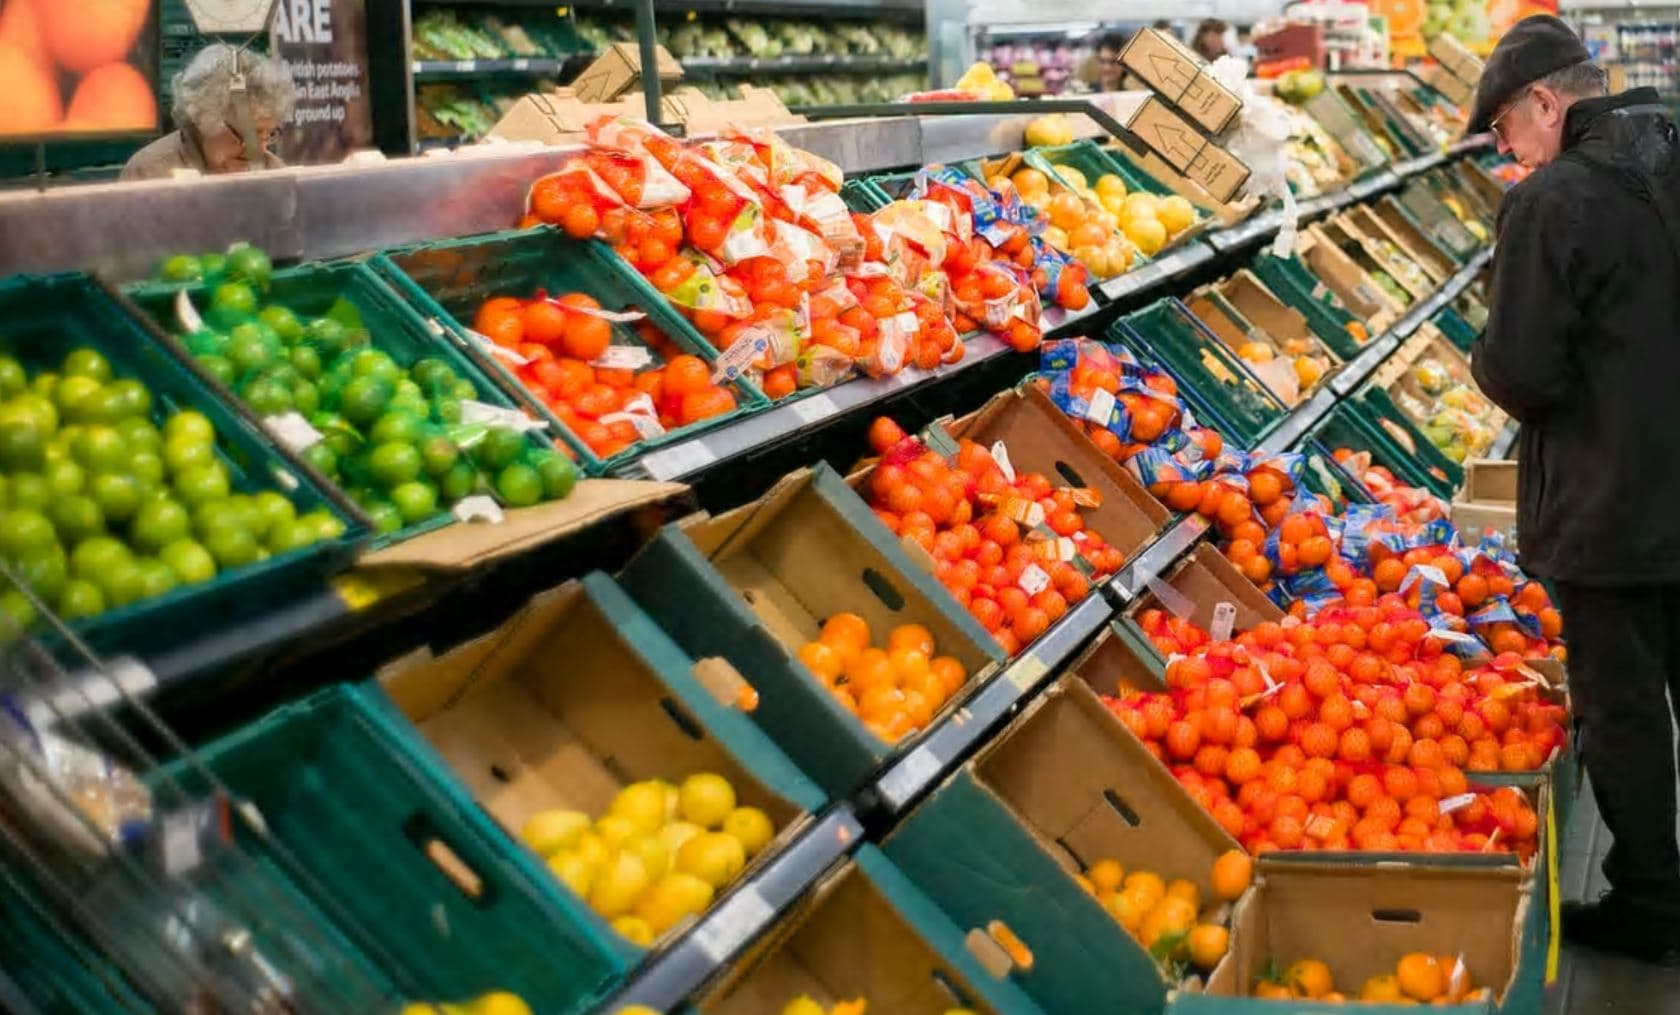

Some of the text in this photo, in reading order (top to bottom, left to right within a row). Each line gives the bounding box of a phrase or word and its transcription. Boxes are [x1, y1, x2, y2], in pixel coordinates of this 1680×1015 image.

[307, 81, 331, 98] East
[295, 104, 331, 126] ground
[332, 106, 345, 124] up
